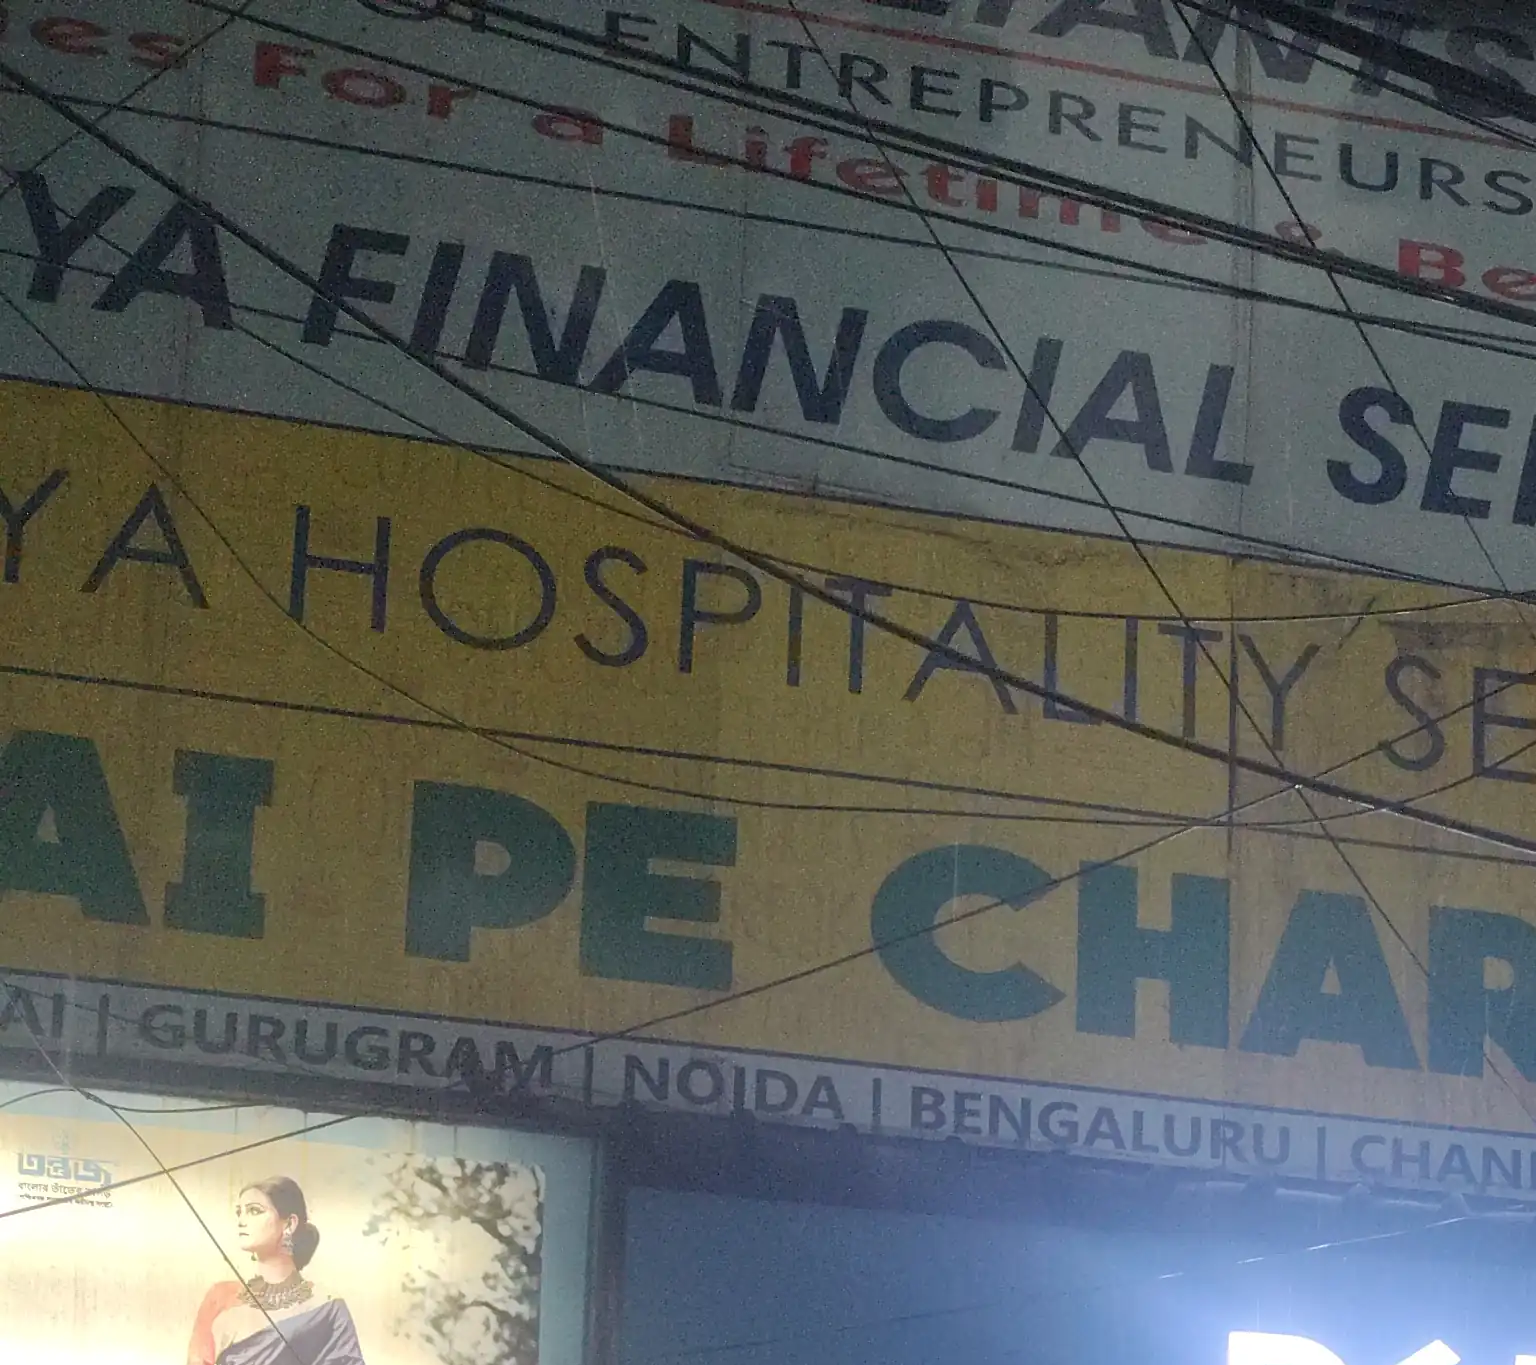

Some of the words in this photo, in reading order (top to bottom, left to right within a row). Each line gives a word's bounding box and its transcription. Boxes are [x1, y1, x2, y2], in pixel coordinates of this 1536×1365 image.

[0, 14, 188, 69] es
[254, 40, 476, 118] For
[532, 108, 604, 145] a
[604, 9, 1534, 216] ENTREPRENEURS
[16, 168, 234, 331] YA
[300, 222, 1254, 486] FINANCIAL
[288, 504, 1321, 752] HOSPITALITY
[404, 779, 738, 992] PE
[138, 1004, 554, 1090] GURUGRAM
[623, 1053, 846, 1121] NOIDA
[908, 1086, 1292, 1165] BENGALURU
